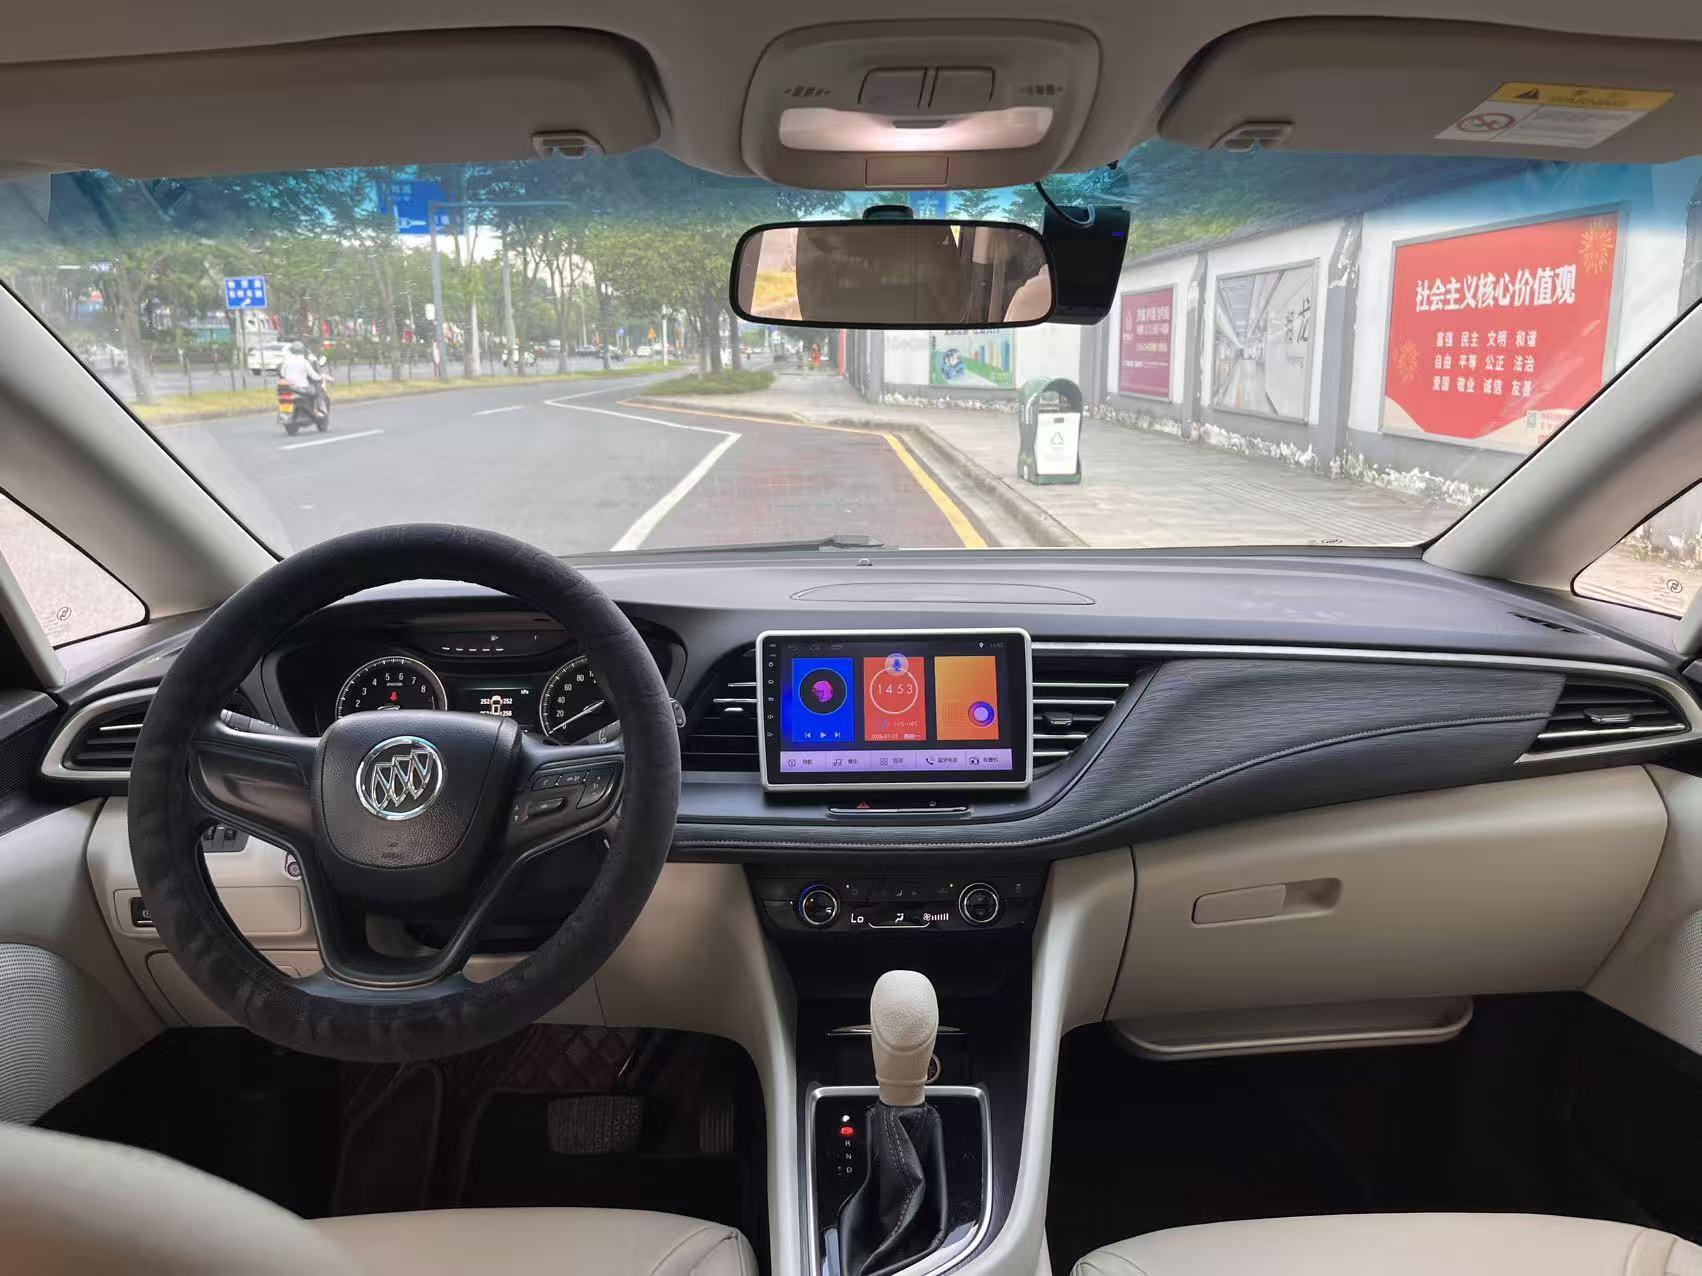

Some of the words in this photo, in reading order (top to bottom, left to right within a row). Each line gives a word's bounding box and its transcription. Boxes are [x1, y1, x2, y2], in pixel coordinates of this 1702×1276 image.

[1416, 264, 1576, 312] 社会主义核心价值观
[1436, 331, 1453, 347] 富强
[1460, 331, 1479, 347] 民主
[1487, 330, 1507, 347] 文明
[1515, 329, 1537, 347] 和谐
[1434, 353, 1452, 369] 自由
[1458, 354, 1477, 370] 平等
[1485, 355, 1504, 371] 公正
[1513, 355, 1535, 372] 法治
[1433, 376, 1449, 391] 爱国
[1456, 377, 1475, 393] 敬业
[1483, 378, 1503, 395] 诚信
[1511, 380, 1532, 397] 友善
[385, 673, 390, 681] 5
[411, 677, 416, 685] 7
[576, 674, 584, 682] 80
[361, 687, 367, 696] 3
[420, 685, 426, 693] 8
[355, 699, 361, 708] 2
[557, 696, 565, 704] 40
[556, 709, 565, 718] 20
[850, 913, 864, 923] Lo
